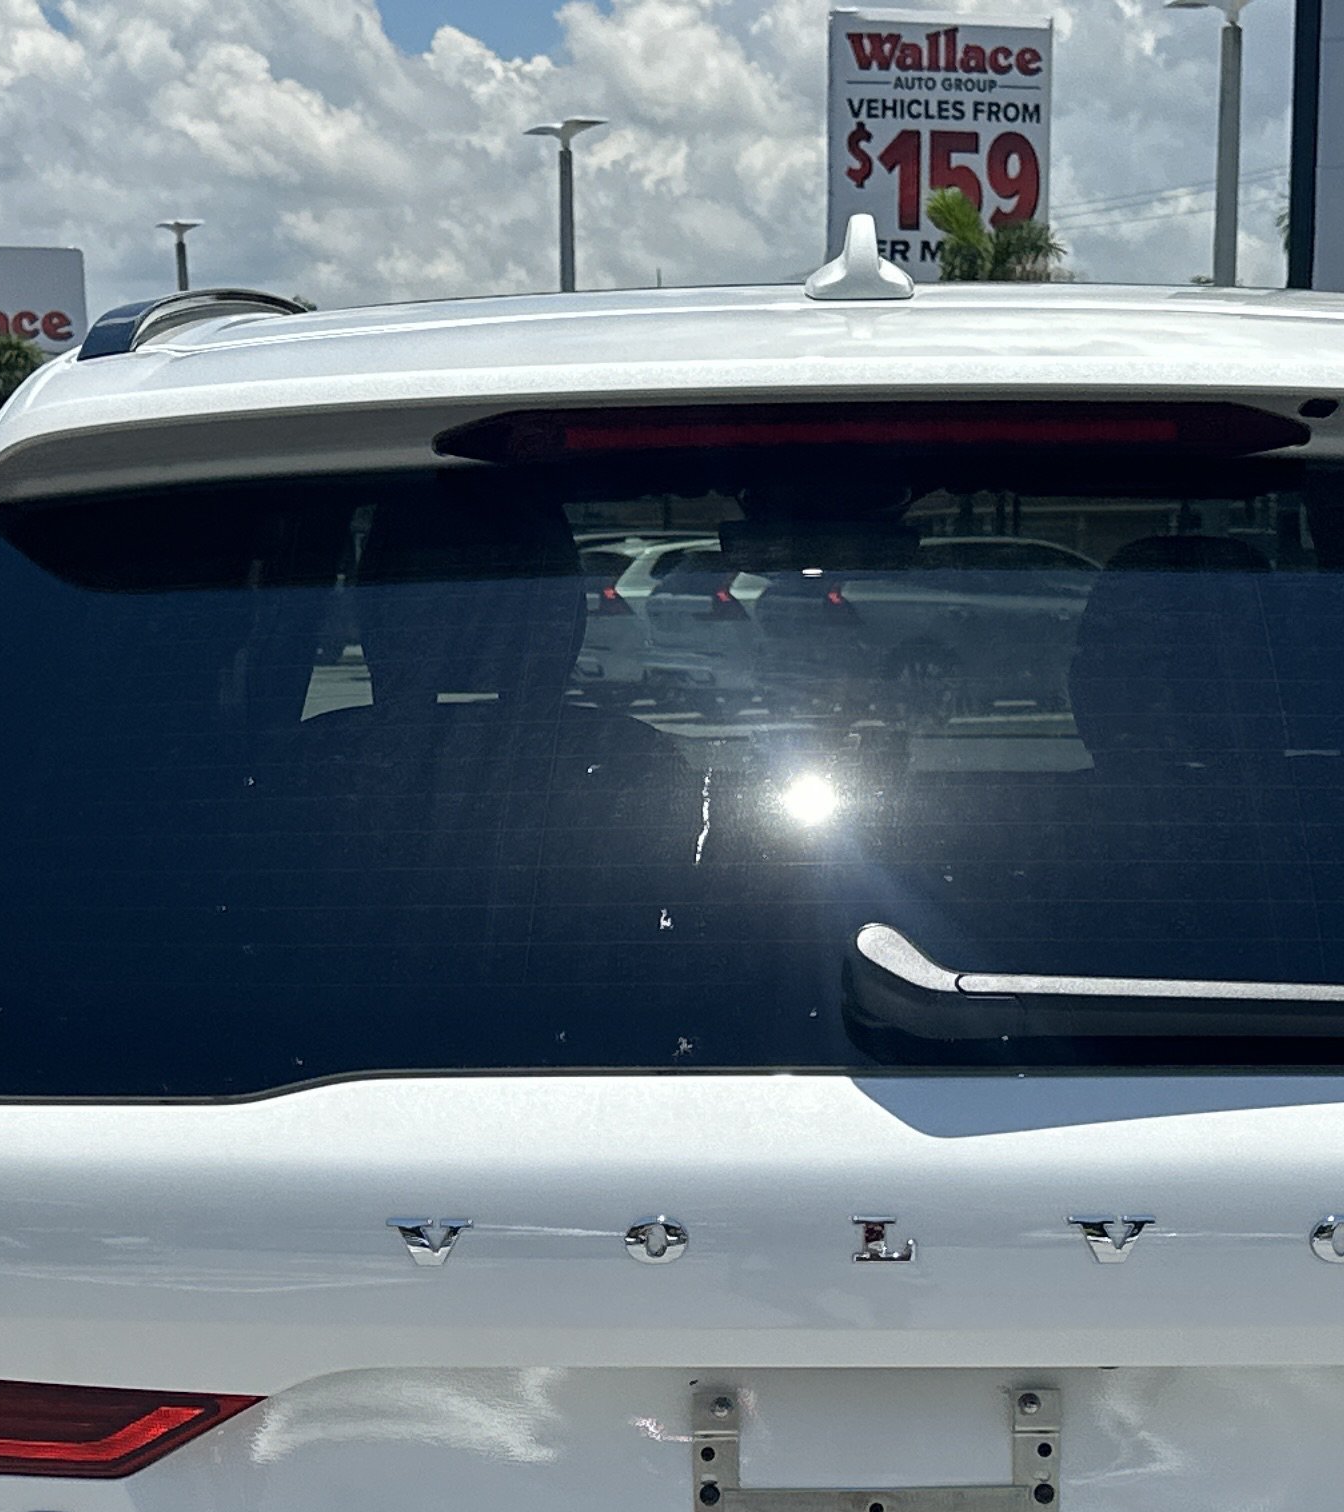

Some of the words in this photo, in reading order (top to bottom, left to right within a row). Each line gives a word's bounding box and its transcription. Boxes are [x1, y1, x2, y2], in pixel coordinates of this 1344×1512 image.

[846, 27, 1043, 76] Wallace
[893, 77, 936, 91] AUTO
[941, 78, 997, 93] GROUP
[847, 98, 965, 121] VEHICLES
[973, 101, 1041, 124] FROM
[846, 121, 1040, 231] $159
